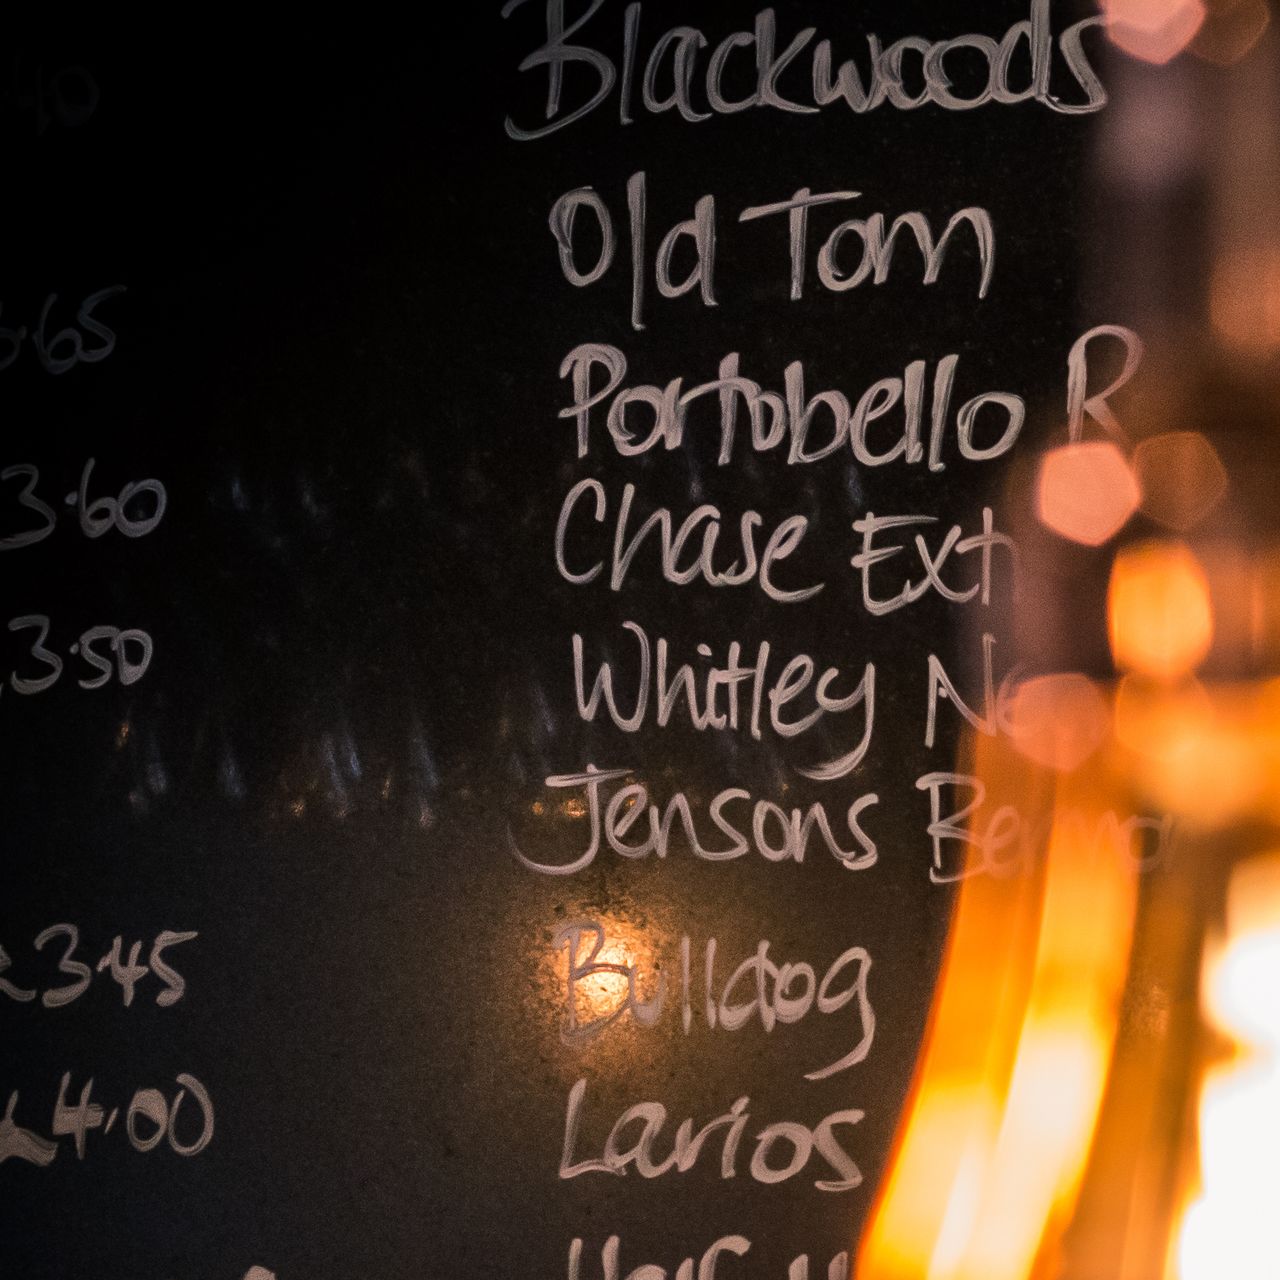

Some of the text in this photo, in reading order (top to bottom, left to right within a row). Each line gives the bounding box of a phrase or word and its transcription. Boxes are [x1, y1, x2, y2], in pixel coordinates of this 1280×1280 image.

[502, 0, 1108, 140] Blackwoods
[548, 170, 996, 330] Old Tom
[558, 342, 1026, 472] Portobello
[554, 478, 825, 602] Chase
[570, 618, 875, 780] Whitley
[505, 762, 880, 875] Jensons
[552, 920, 875, 1080] Bulldog
[557, 1078, 866, 1192] Larios
